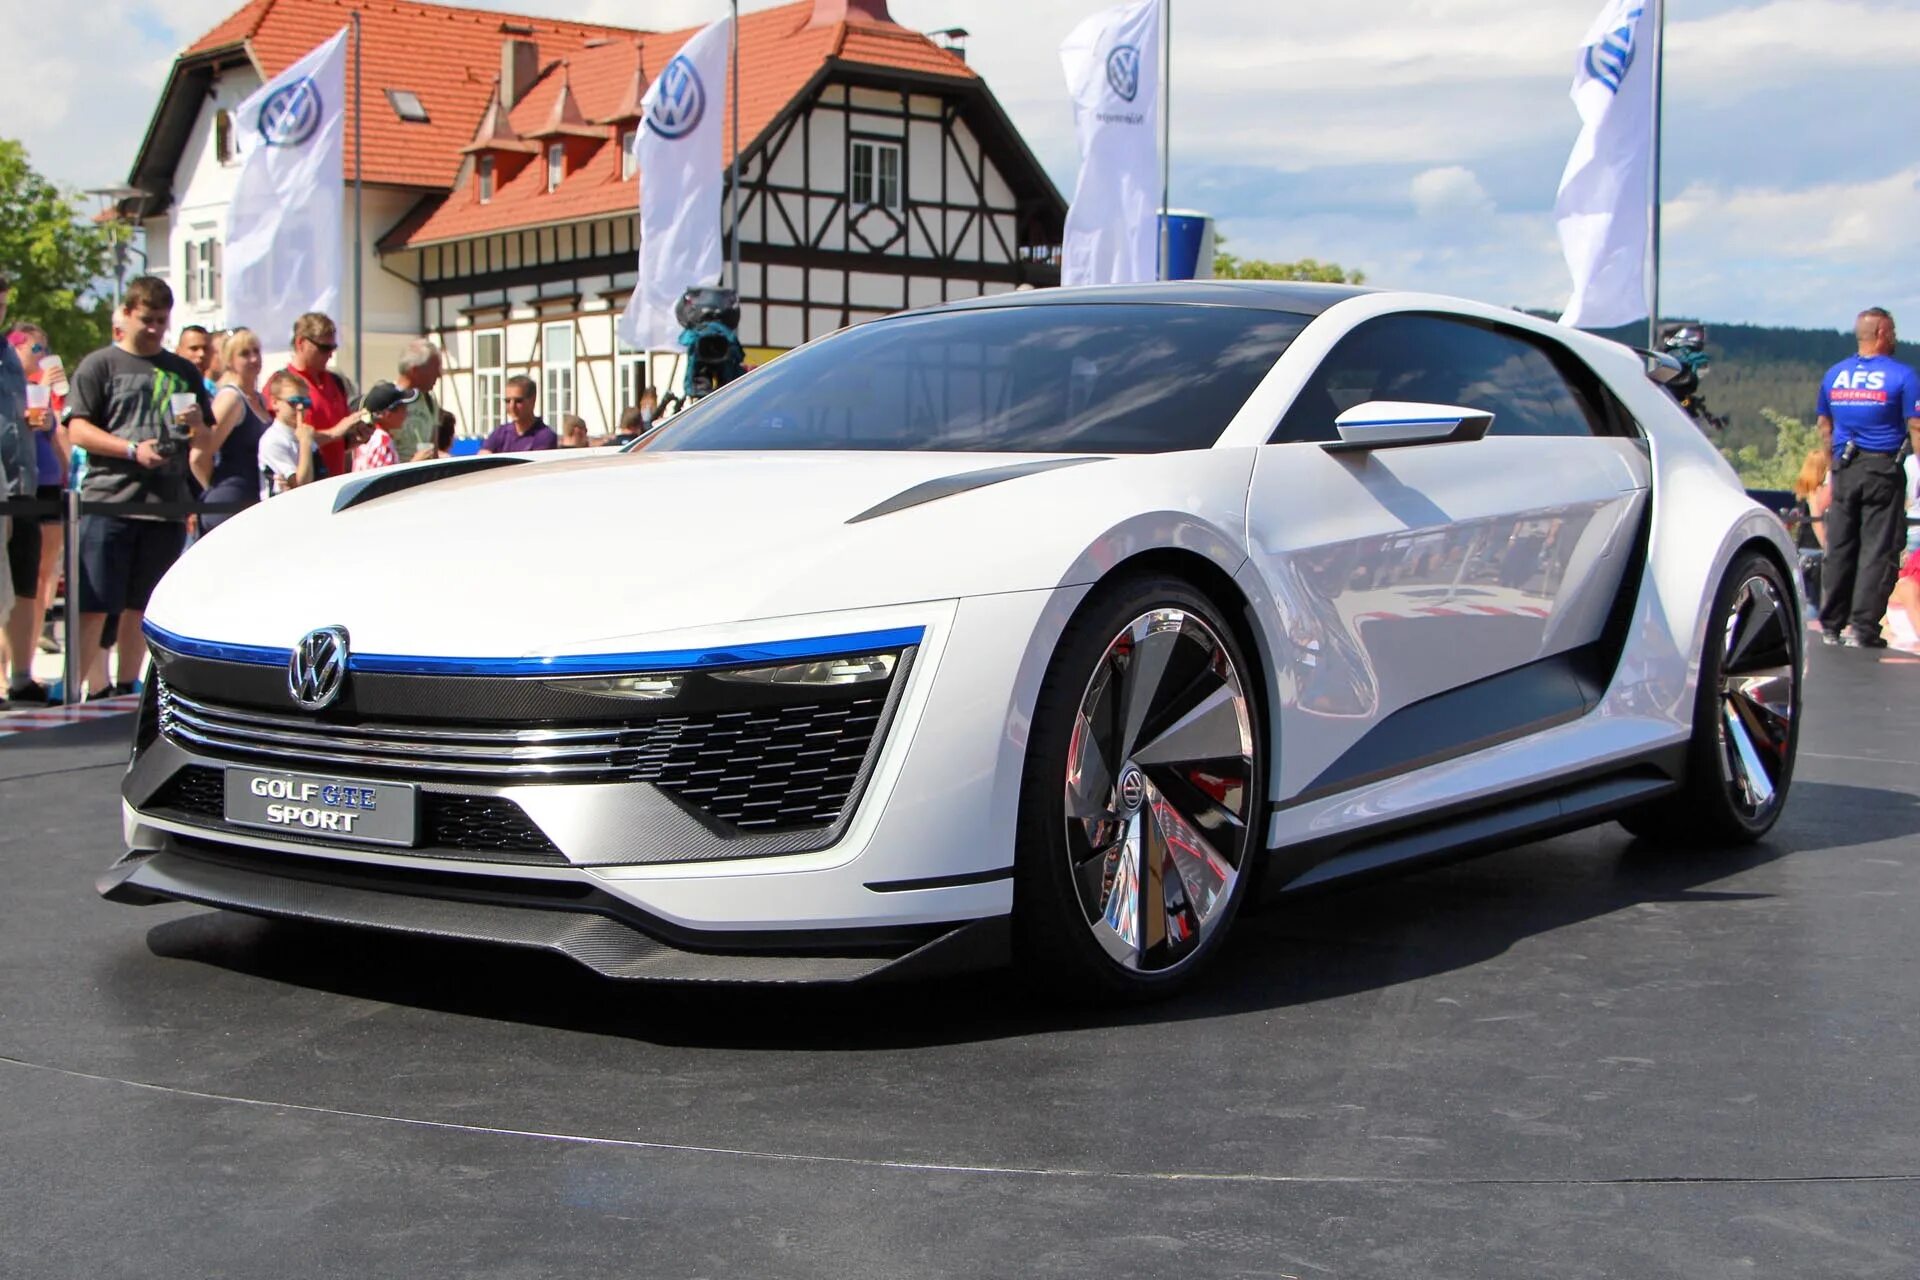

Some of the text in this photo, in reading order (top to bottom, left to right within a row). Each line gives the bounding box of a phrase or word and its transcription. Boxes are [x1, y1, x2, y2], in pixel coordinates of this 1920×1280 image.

[650, 57, 703, 134] VW
[1832, 370, 1885, 390] AFS
[290, 628, 343, 707] VW
[251, 777, 377, 809] GOLF GTE
[1123, 769, 1143, 808] VW
[266, 804, 359, 833] SPORT
